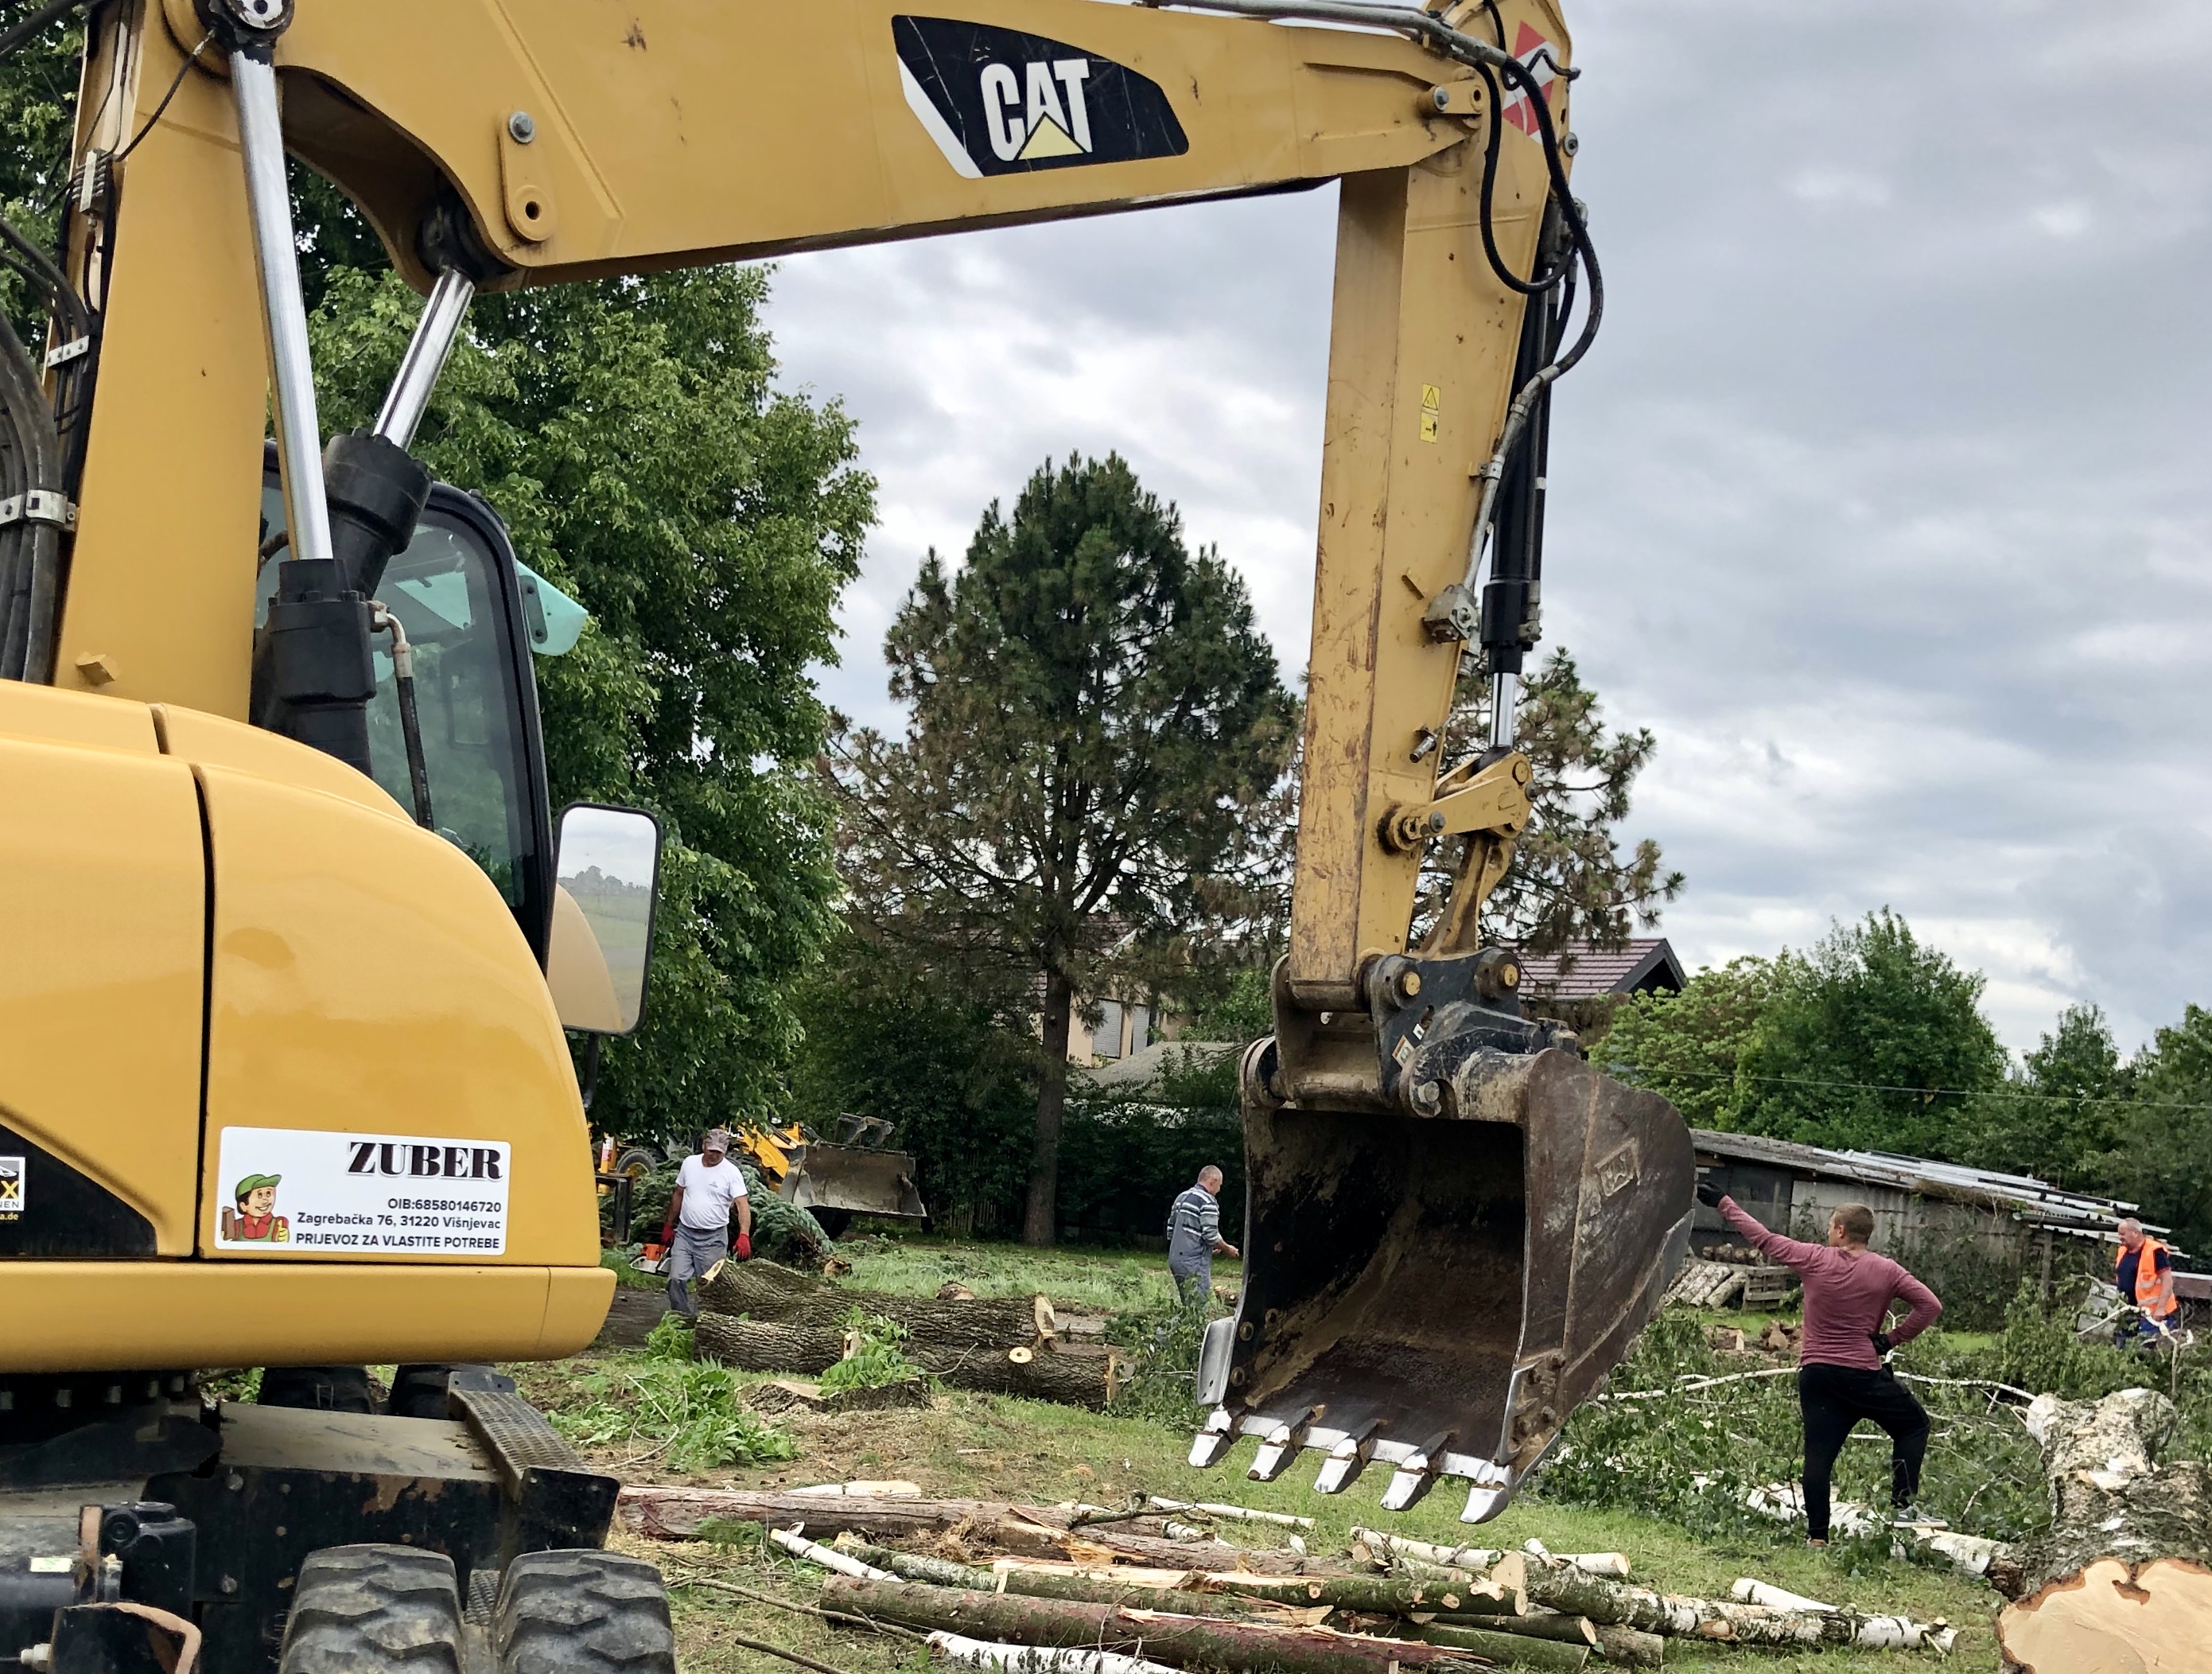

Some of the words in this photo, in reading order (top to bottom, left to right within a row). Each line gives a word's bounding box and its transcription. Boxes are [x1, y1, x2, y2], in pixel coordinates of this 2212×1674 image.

[980, 58, 1093, 162] CAT
[348, 1142, 503, 1179] ZUBER
[387, 1198, 501, 1213] OIB:68580146720
[297, 1212, 373, 1226] Zagrebačka
[377, 1215, 397, 1227] 76,
[400, 1215, 439, 1227] 31220
[442, 1217, 501, 1231] Višnjevac
[296, 1233, 359, 1245] PRIJEVOZ
[362, 1235, 379, 1246] ZA
[383, 1235, 441, 1248] VLASTITE
[444, 1237, 500, 1248] POTREBE
